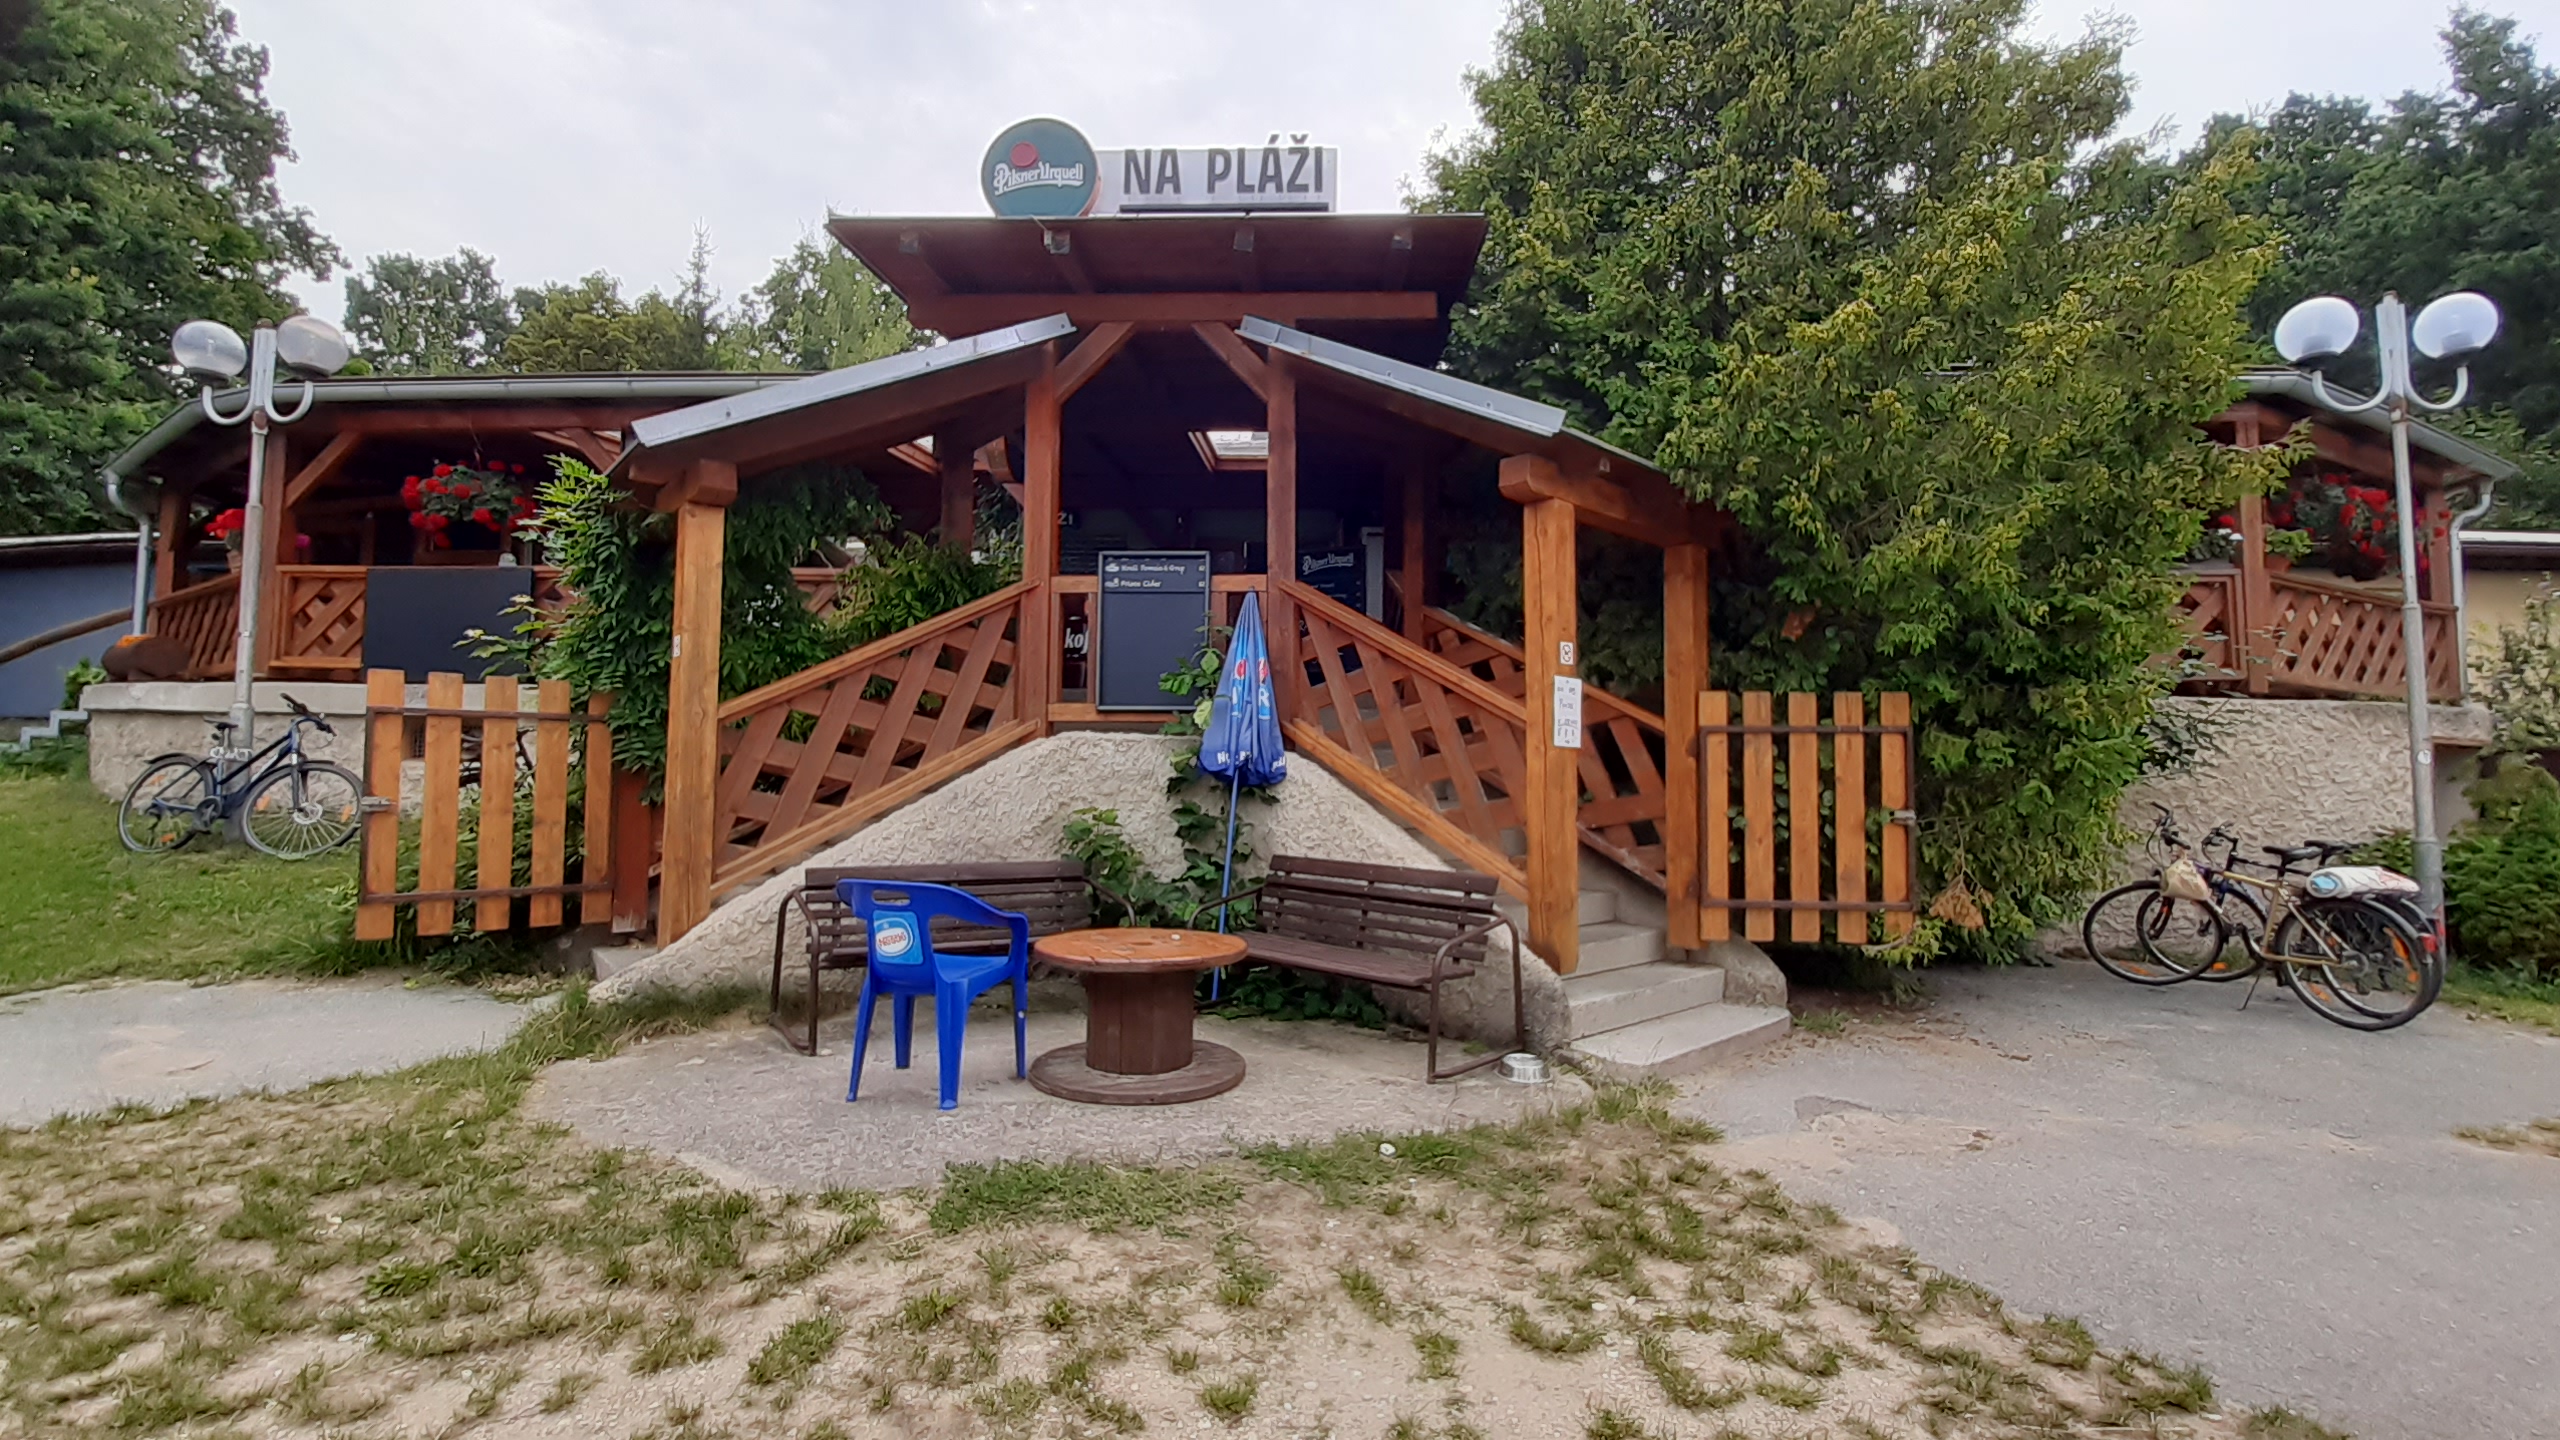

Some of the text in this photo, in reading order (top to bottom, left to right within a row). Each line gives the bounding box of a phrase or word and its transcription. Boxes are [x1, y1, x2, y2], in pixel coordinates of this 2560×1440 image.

[993, 161, 1084, 196] Pilsner Urquell
[1123, 133, 1324, 195] NA PLÁŽI
